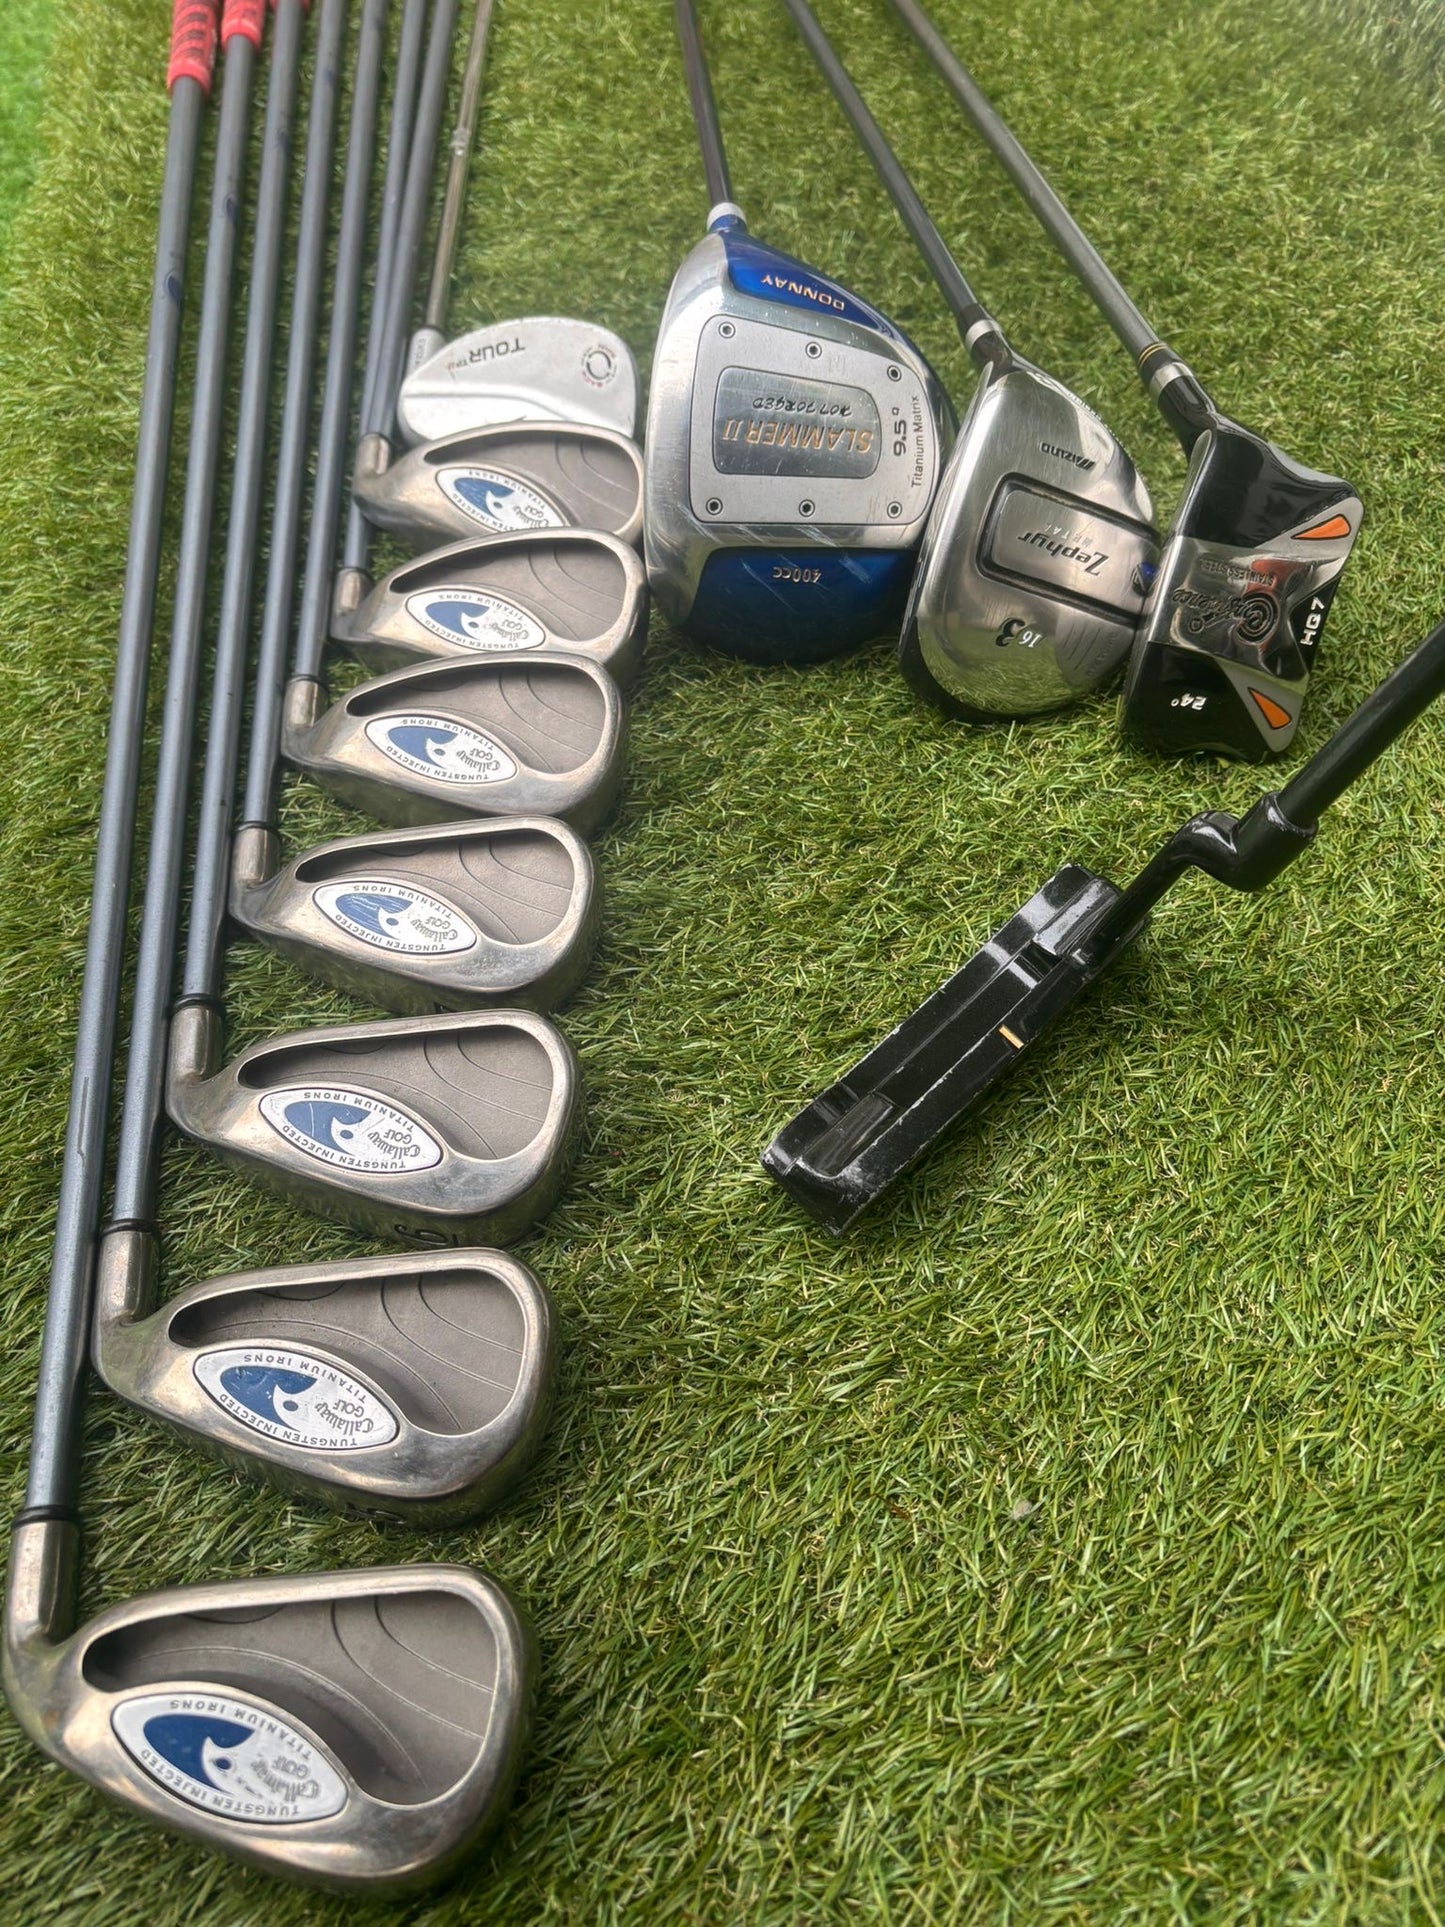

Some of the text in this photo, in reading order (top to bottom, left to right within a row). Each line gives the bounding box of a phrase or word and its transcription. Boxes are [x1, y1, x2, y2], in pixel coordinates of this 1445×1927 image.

[760, 273, 845, 311] DONNAY
[469, 338, 525, 363] TOUR
[752, 396, 852, 418] HOT FORGED
[720, 418, 875, 455] SLAMMER II
[911, 395, 923, 488] Titanium Matrix
[452, 493, 490, 523] INJECTED
[1018, 531, 1110, 577] Zephyr
[773, 566, 822, 584] 400cc
[476, 596, 524, 621] TITANIUM
[425, 619, 519, 649] TUNGSTEN INJECTED
[995, 617, 1027, 648] 3
[1019, 628, 1044, 649] 16
[402, 718, 494, 751] TITANIUM IRONS
[386, 745, 489, 780] TUNGSTEN INJECTED
[456, 749, 501, 773] Callaway
[353, 885, 453, 919] TITANIUM IRONS
[335, 914, 446, 951] TUNGSTEN INJECTED
[410, 919, 458, 943] Callaway
[424, 916, 451, 930] GOLF
[303, 1092, 414, 1132] TITANIUM IRONS
[282, 1124, 406, 1169] TUNGSTEN INJECTED
[367, 1131, 421, 1160] Callaway
[383, 1129, 413, 1145] GOLF
[244, 1354, 366, 1403] TITANIUM IRONS
[219, 1393, 358, 1447] TUNGSTEN INJECTED
[314, 1401, 374, 1436] Callaway
[332, 1399, 365, 1417] GOLF
[169, 1699, 313, 1760] TITANIUM IRONS
[140, 1748, 300, 1817] TUNGSTEN INJECTED
